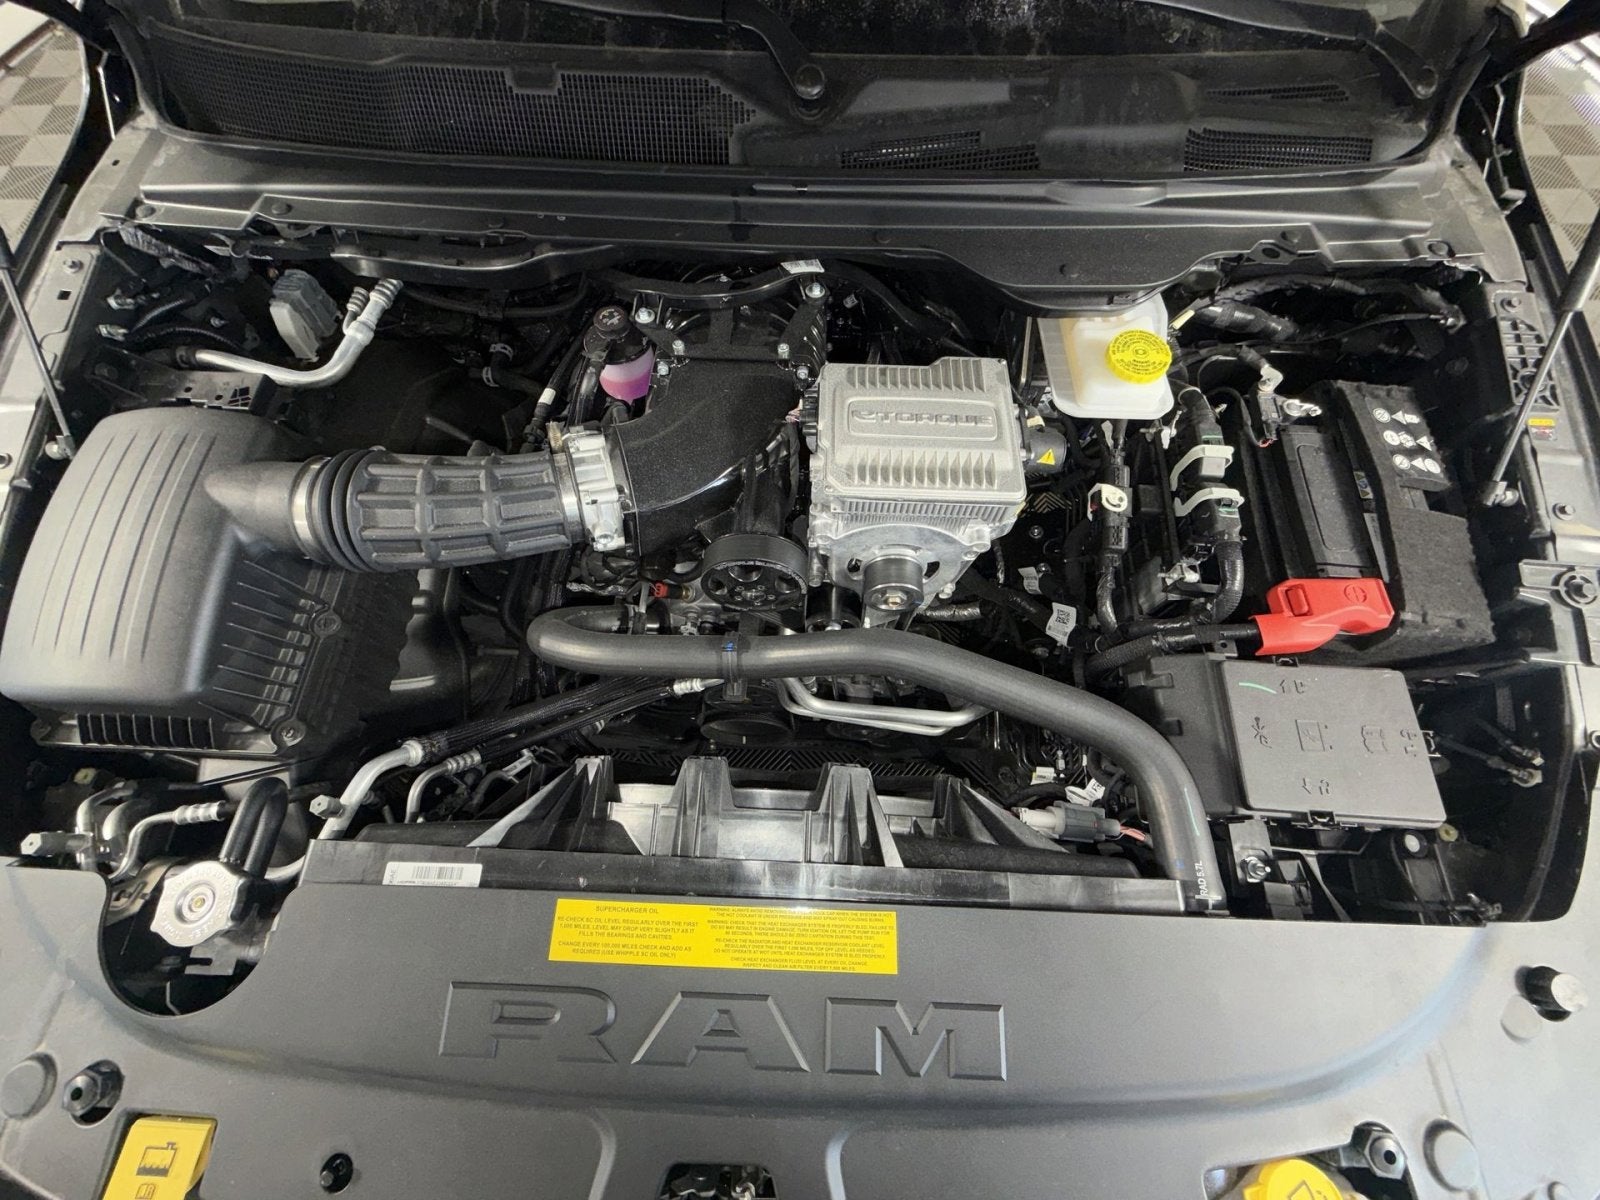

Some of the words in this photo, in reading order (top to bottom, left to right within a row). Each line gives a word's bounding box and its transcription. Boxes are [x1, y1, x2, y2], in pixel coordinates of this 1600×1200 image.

[1194, 860, 1205, 877] 5.7L
[1197, 878, 1208, 896] RAD
[438, 981, 1008, 1081] RAM
